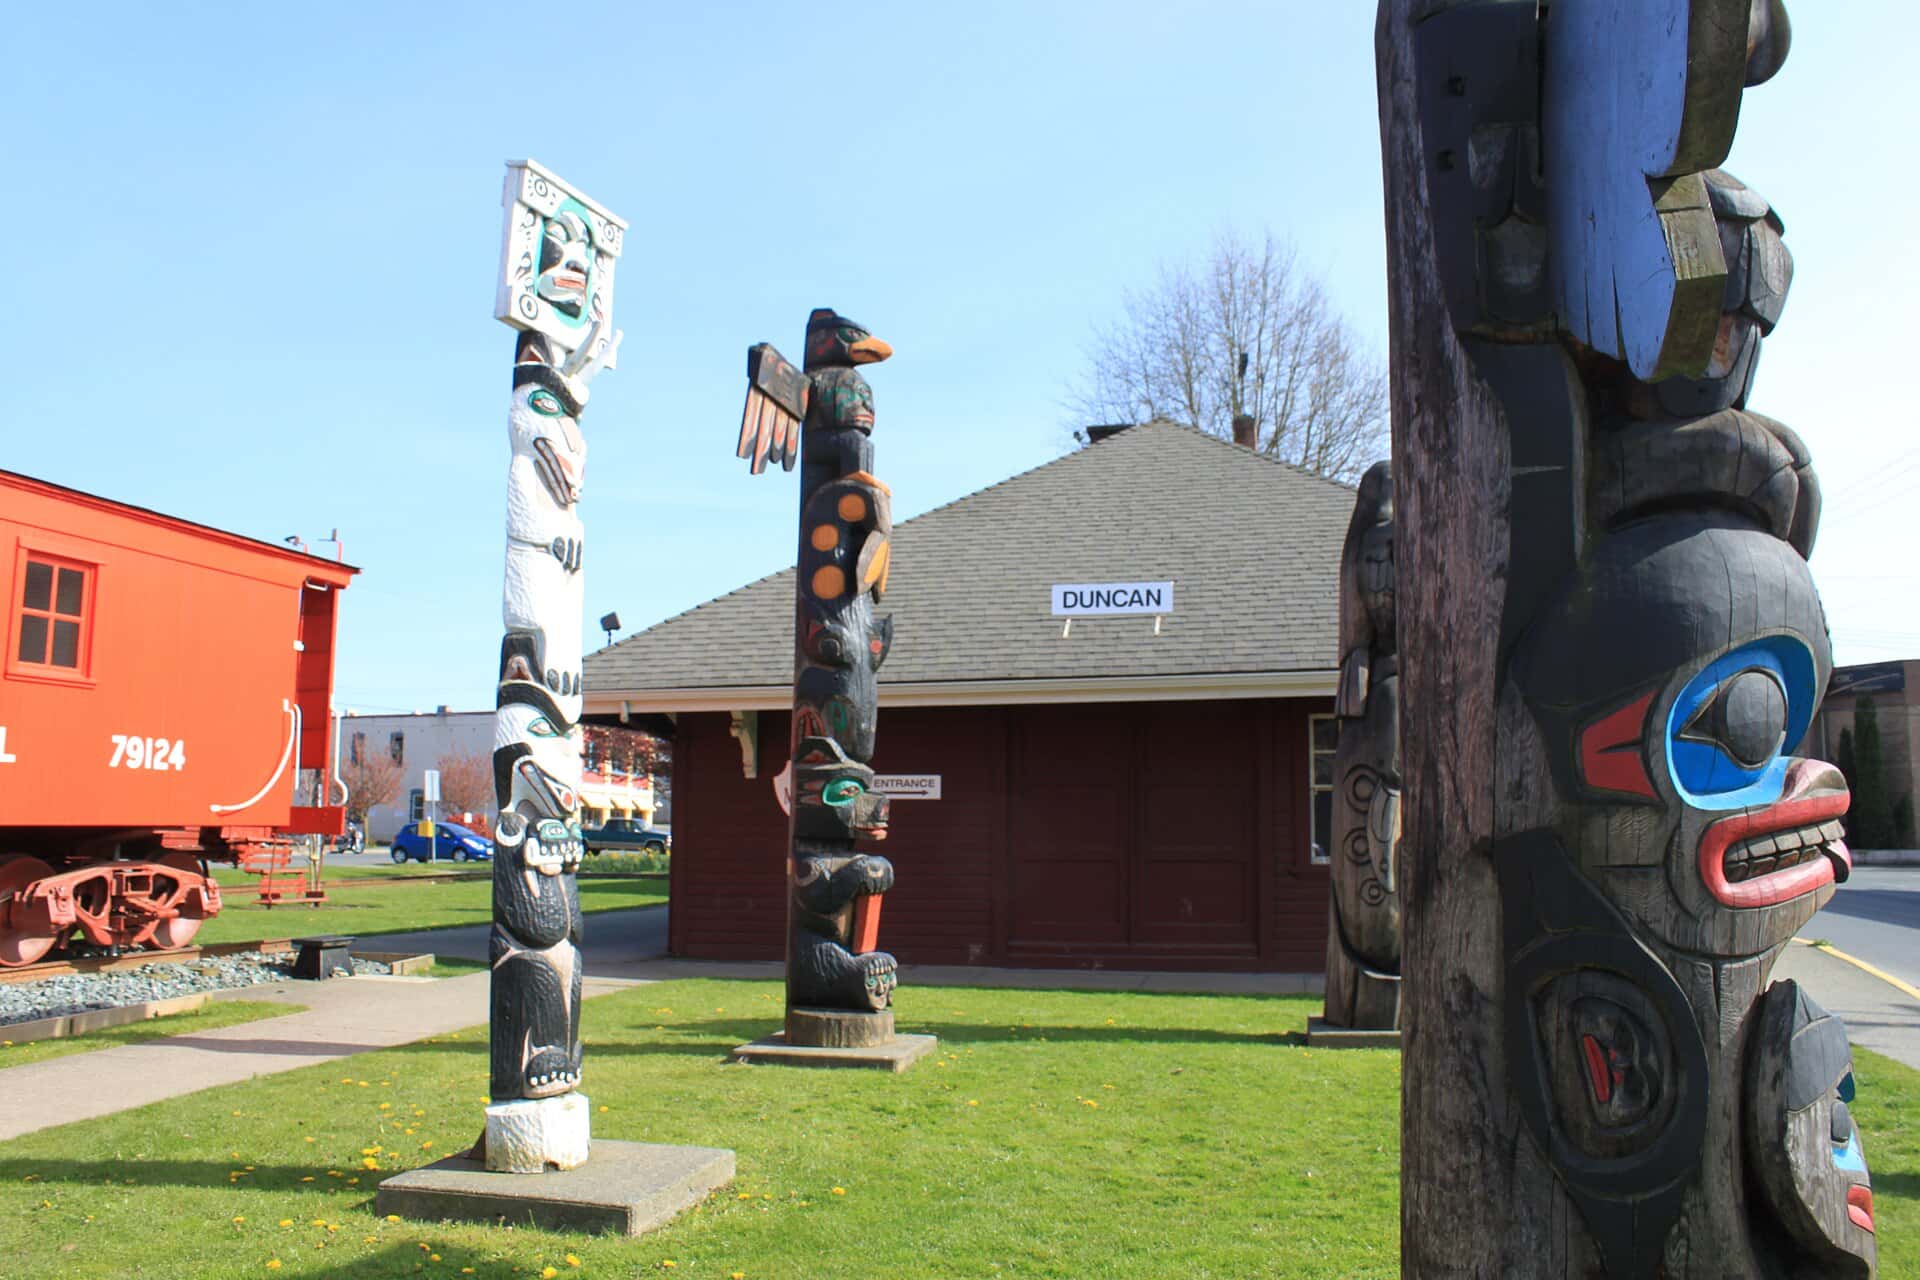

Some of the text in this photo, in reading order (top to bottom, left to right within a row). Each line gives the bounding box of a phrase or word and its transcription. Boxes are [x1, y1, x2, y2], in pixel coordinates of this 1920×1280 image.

[1063, 588, 1162, 609] DUNCAN
[109, 735, 186, 771] 79124
[873, 778, 936, 789] ENTRANCE
